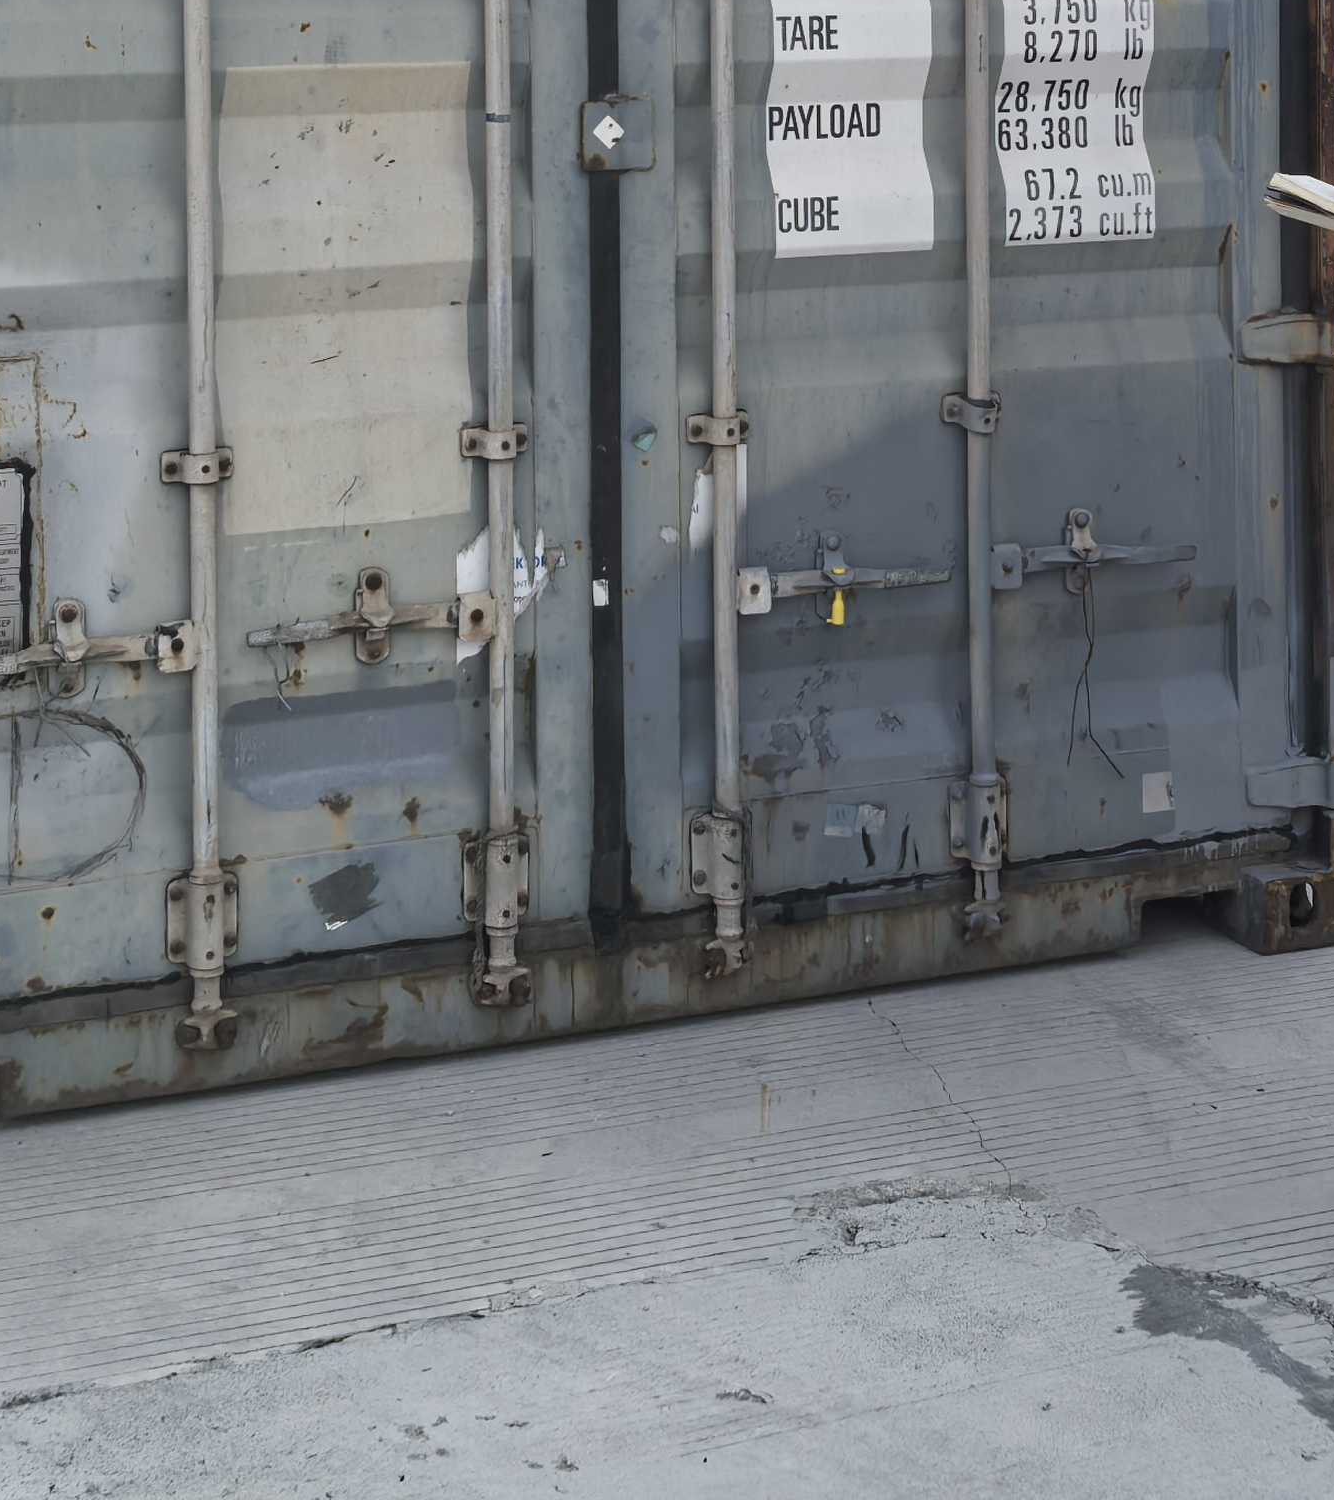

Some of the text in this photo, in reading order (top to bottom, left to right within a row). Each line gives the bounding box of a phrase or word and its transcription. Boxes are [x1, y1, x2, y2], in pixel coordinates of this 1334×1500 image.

[776, 14, 839, 52] TARE
[1024, 27, 1144, 63] 8,270 lb
[768, 78, 1142, 141] PAYLOAD 28,750 kg
[1115, 114, 1134, 147] lb
[1024, 167, 1152, 201] 67.2 cu.m
[778, 195, 840, 233] CUBE
[1009, 203, 1155, 242] 2,373 cu.ft
